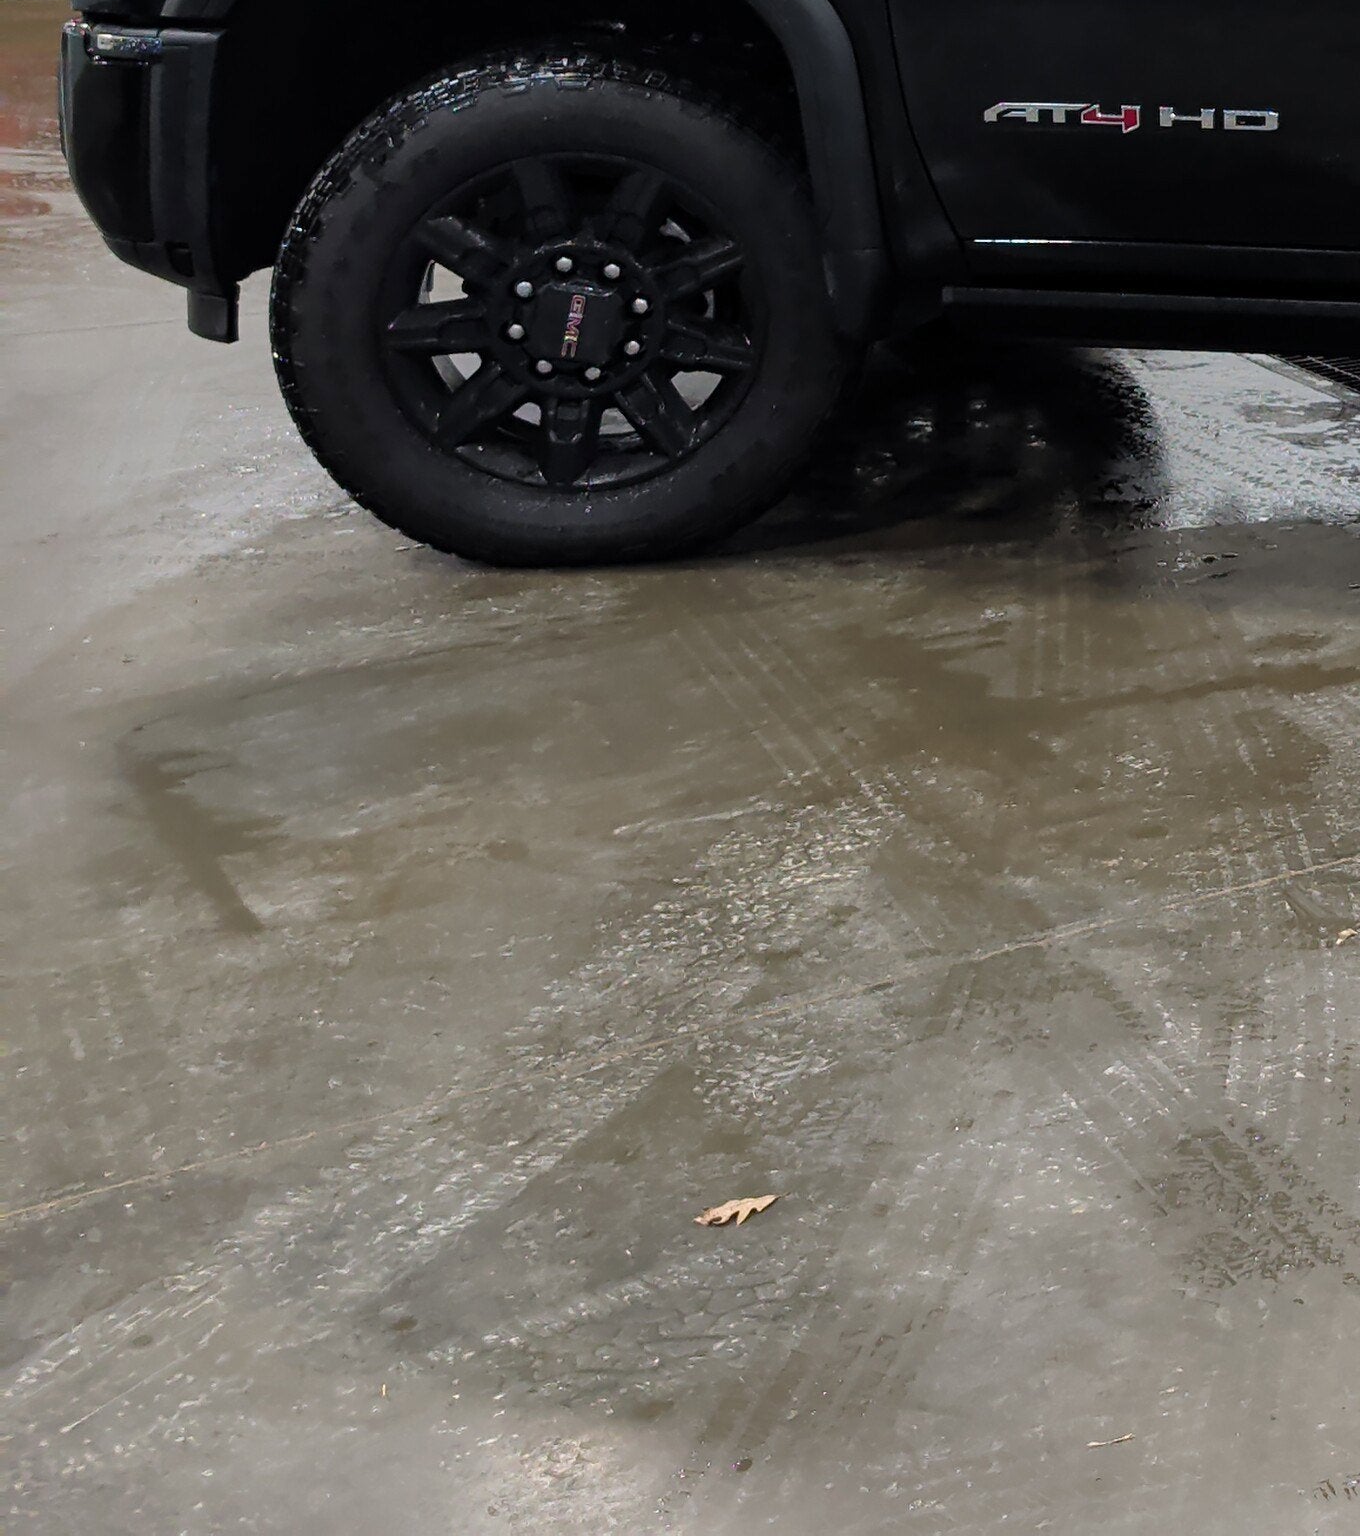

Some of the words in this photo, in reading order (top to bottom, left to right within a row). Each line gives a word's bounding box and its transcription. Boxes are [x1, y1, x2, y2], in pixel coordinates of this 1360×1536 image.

[983, 101, 1141, 133] AT4
[1158, 105, 1279, 131] HD
[560, 294, 586, 358] GMC
